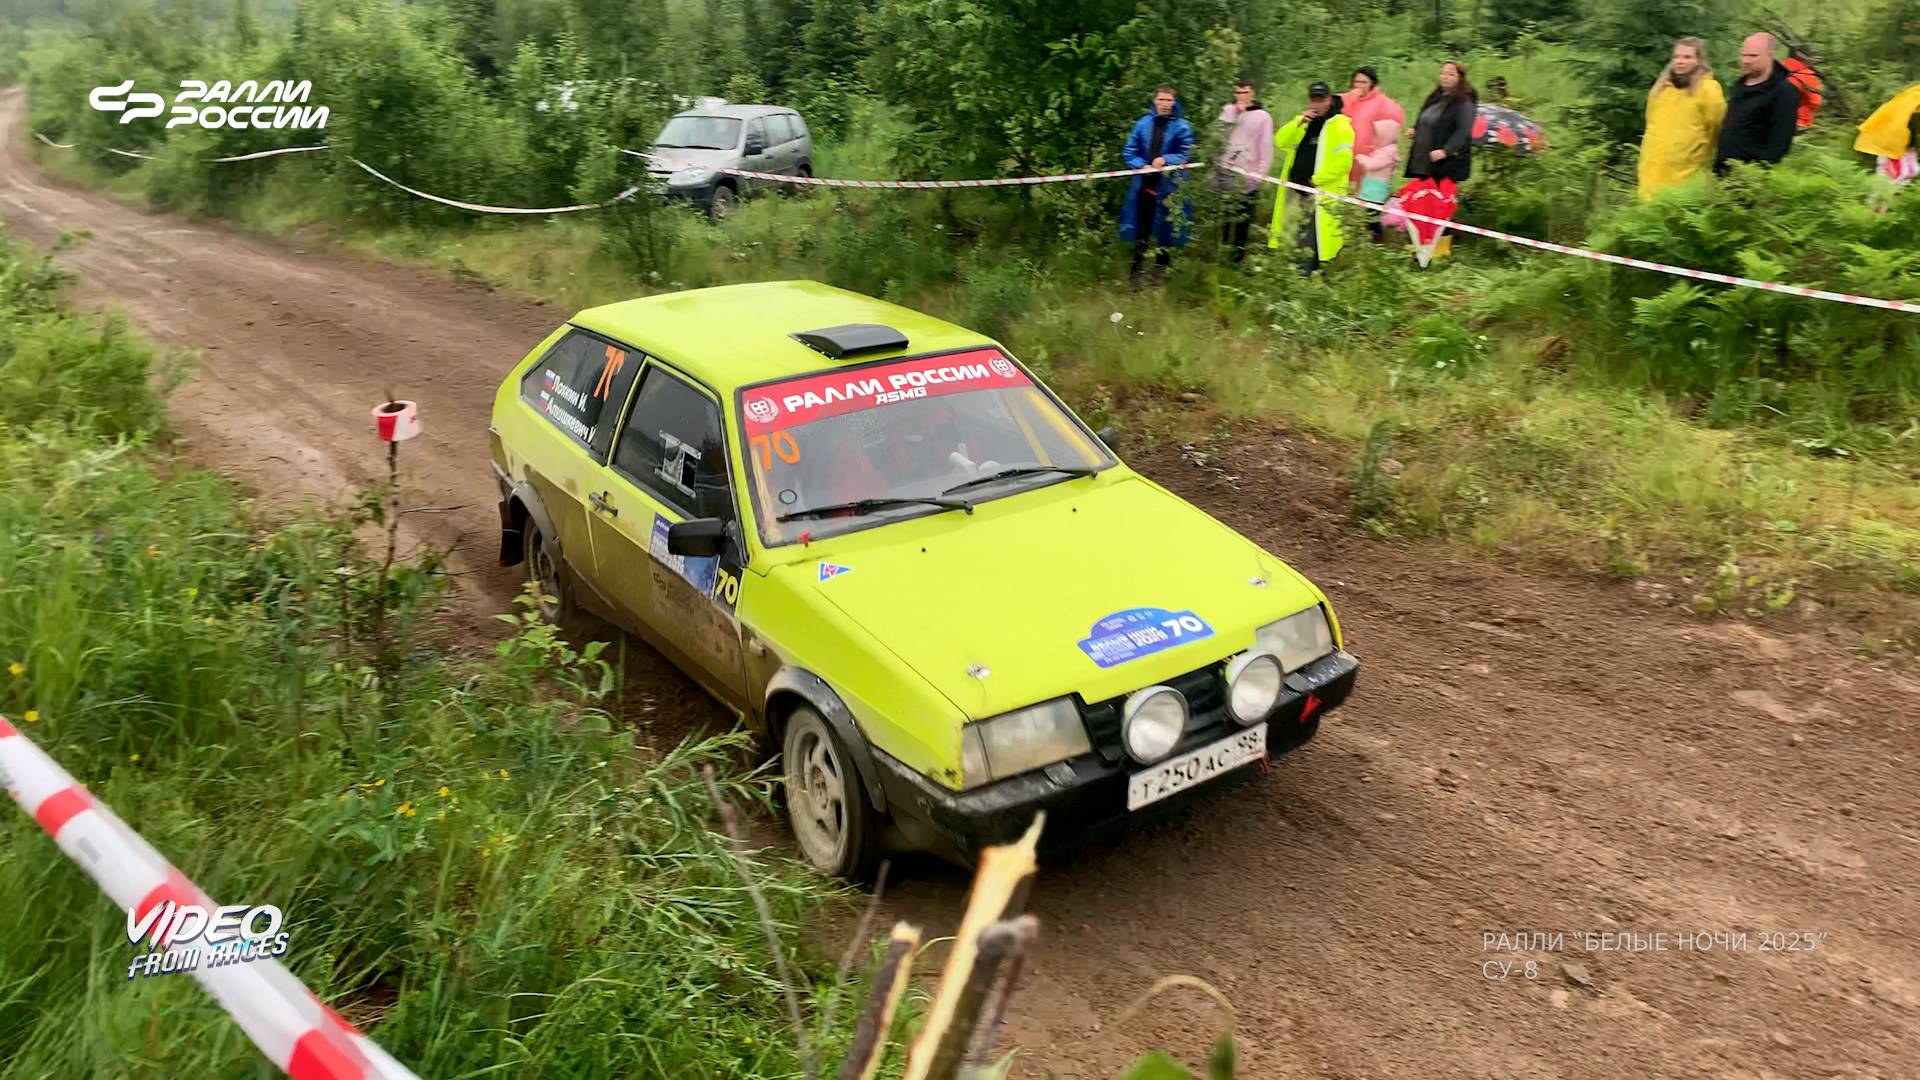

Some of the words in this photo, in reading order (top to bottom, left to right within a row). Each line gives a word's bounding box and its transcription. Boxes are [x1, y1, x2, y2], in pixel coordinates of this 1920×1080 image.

[783, 378, 885, 413] РАЛЛИ
[888, 364, 991, 389] РОССИИ
[876, 387, 927, 404] ASMG
[752, 430, 801, 473] 70
[715, 567, 739, 605] 70
[1160, 615, 1204, 638] 70
